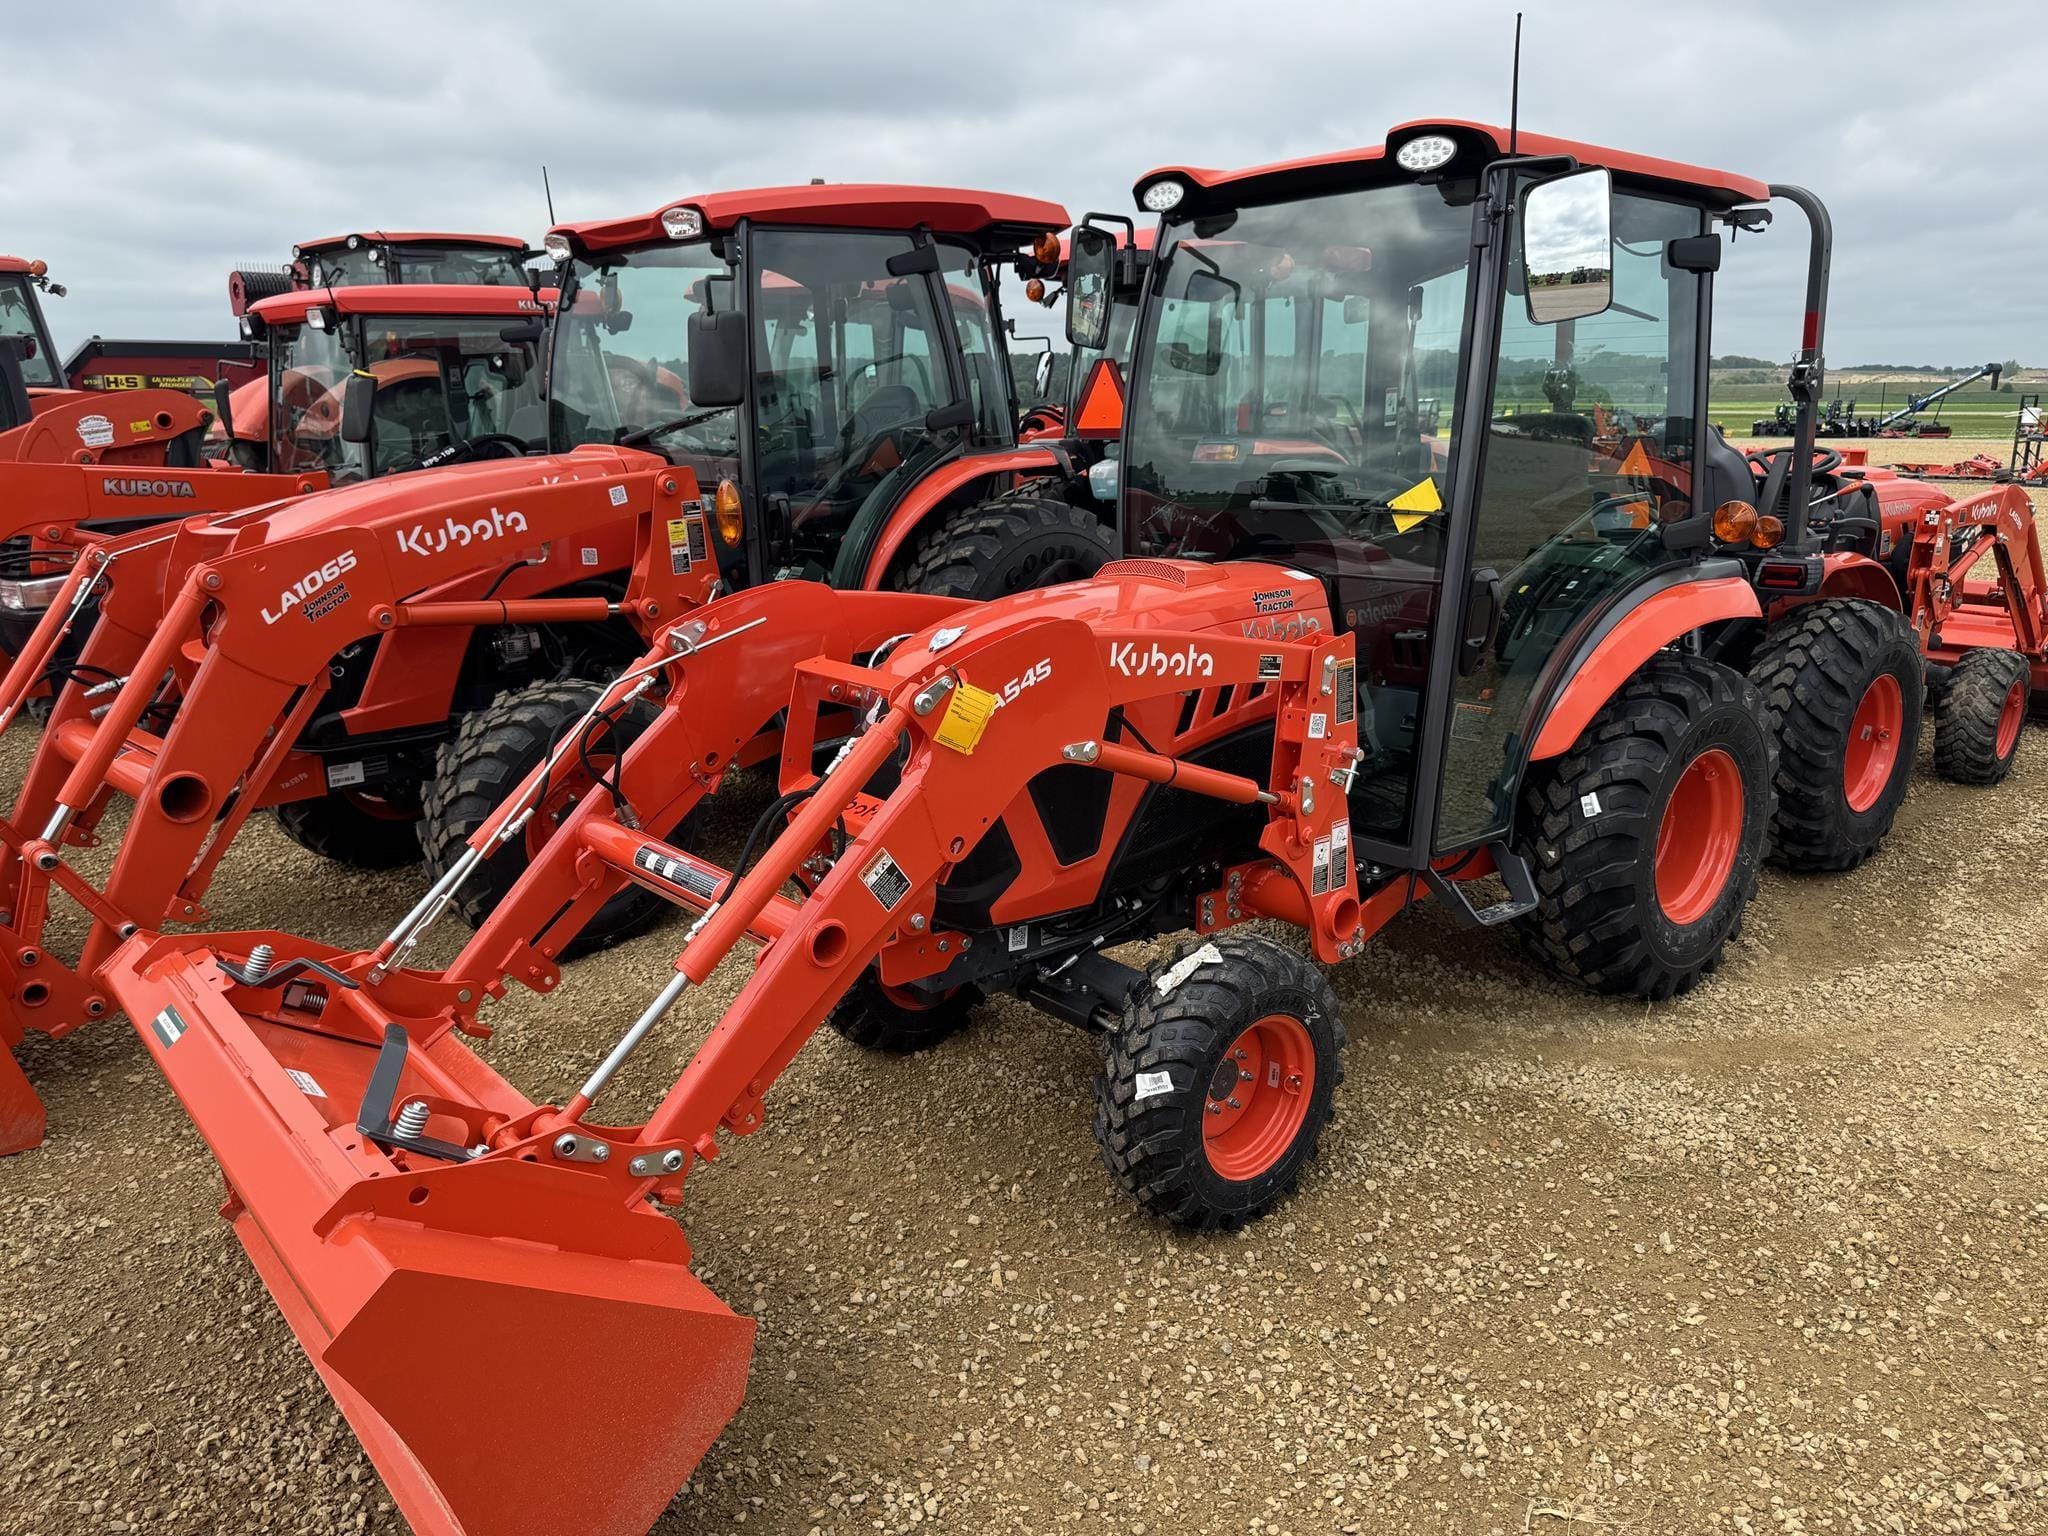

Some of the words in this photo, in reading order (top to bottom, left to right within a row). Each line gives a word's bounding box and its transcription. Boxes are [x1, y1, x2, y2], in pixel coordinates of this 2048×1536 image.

[106, 376, 138, 388] H&S
[103, 478, 196, 498] KUBOTA
[1971, 501, 1998, 520] Kubota
[396, 507, 528, 556] Kubota
[260, 549, 358, 625] LA1065
[302, 582, 345, 615] JOHNSON
[1252, 589, 1292, 602] JOHNSON
[306, 591, 351, 623] TRACTOR
[1255, 600, 1294, 613] TRACTOR
[1242, 612, 1321, 641] Kubota
[1109, 642, 1214, 677] Kubota
[990, 657, 1052, 717] A545
